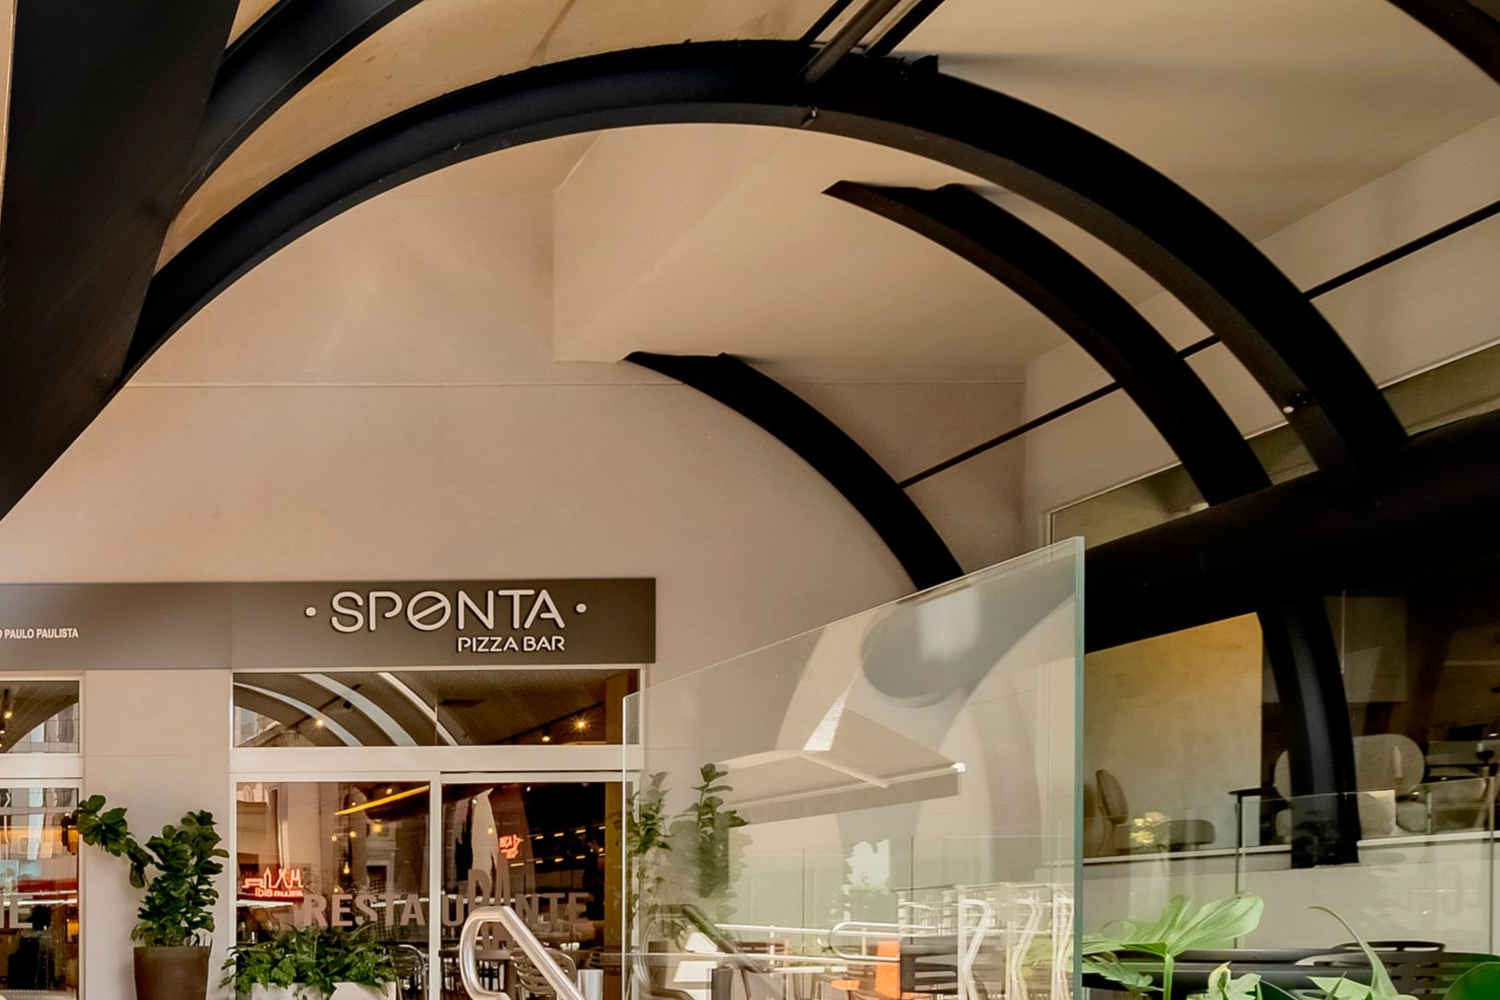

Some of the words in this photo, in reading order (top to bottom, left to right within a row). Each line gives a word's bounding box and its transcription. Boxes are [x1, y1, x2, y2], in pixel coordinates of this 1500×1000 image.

[4, 628, 34, 639] PAULO
[36, 628, 79, 639] PAULISTA
[458, 637, 519, 652] PIZZA
[523, 636, 565, 651] BAR
